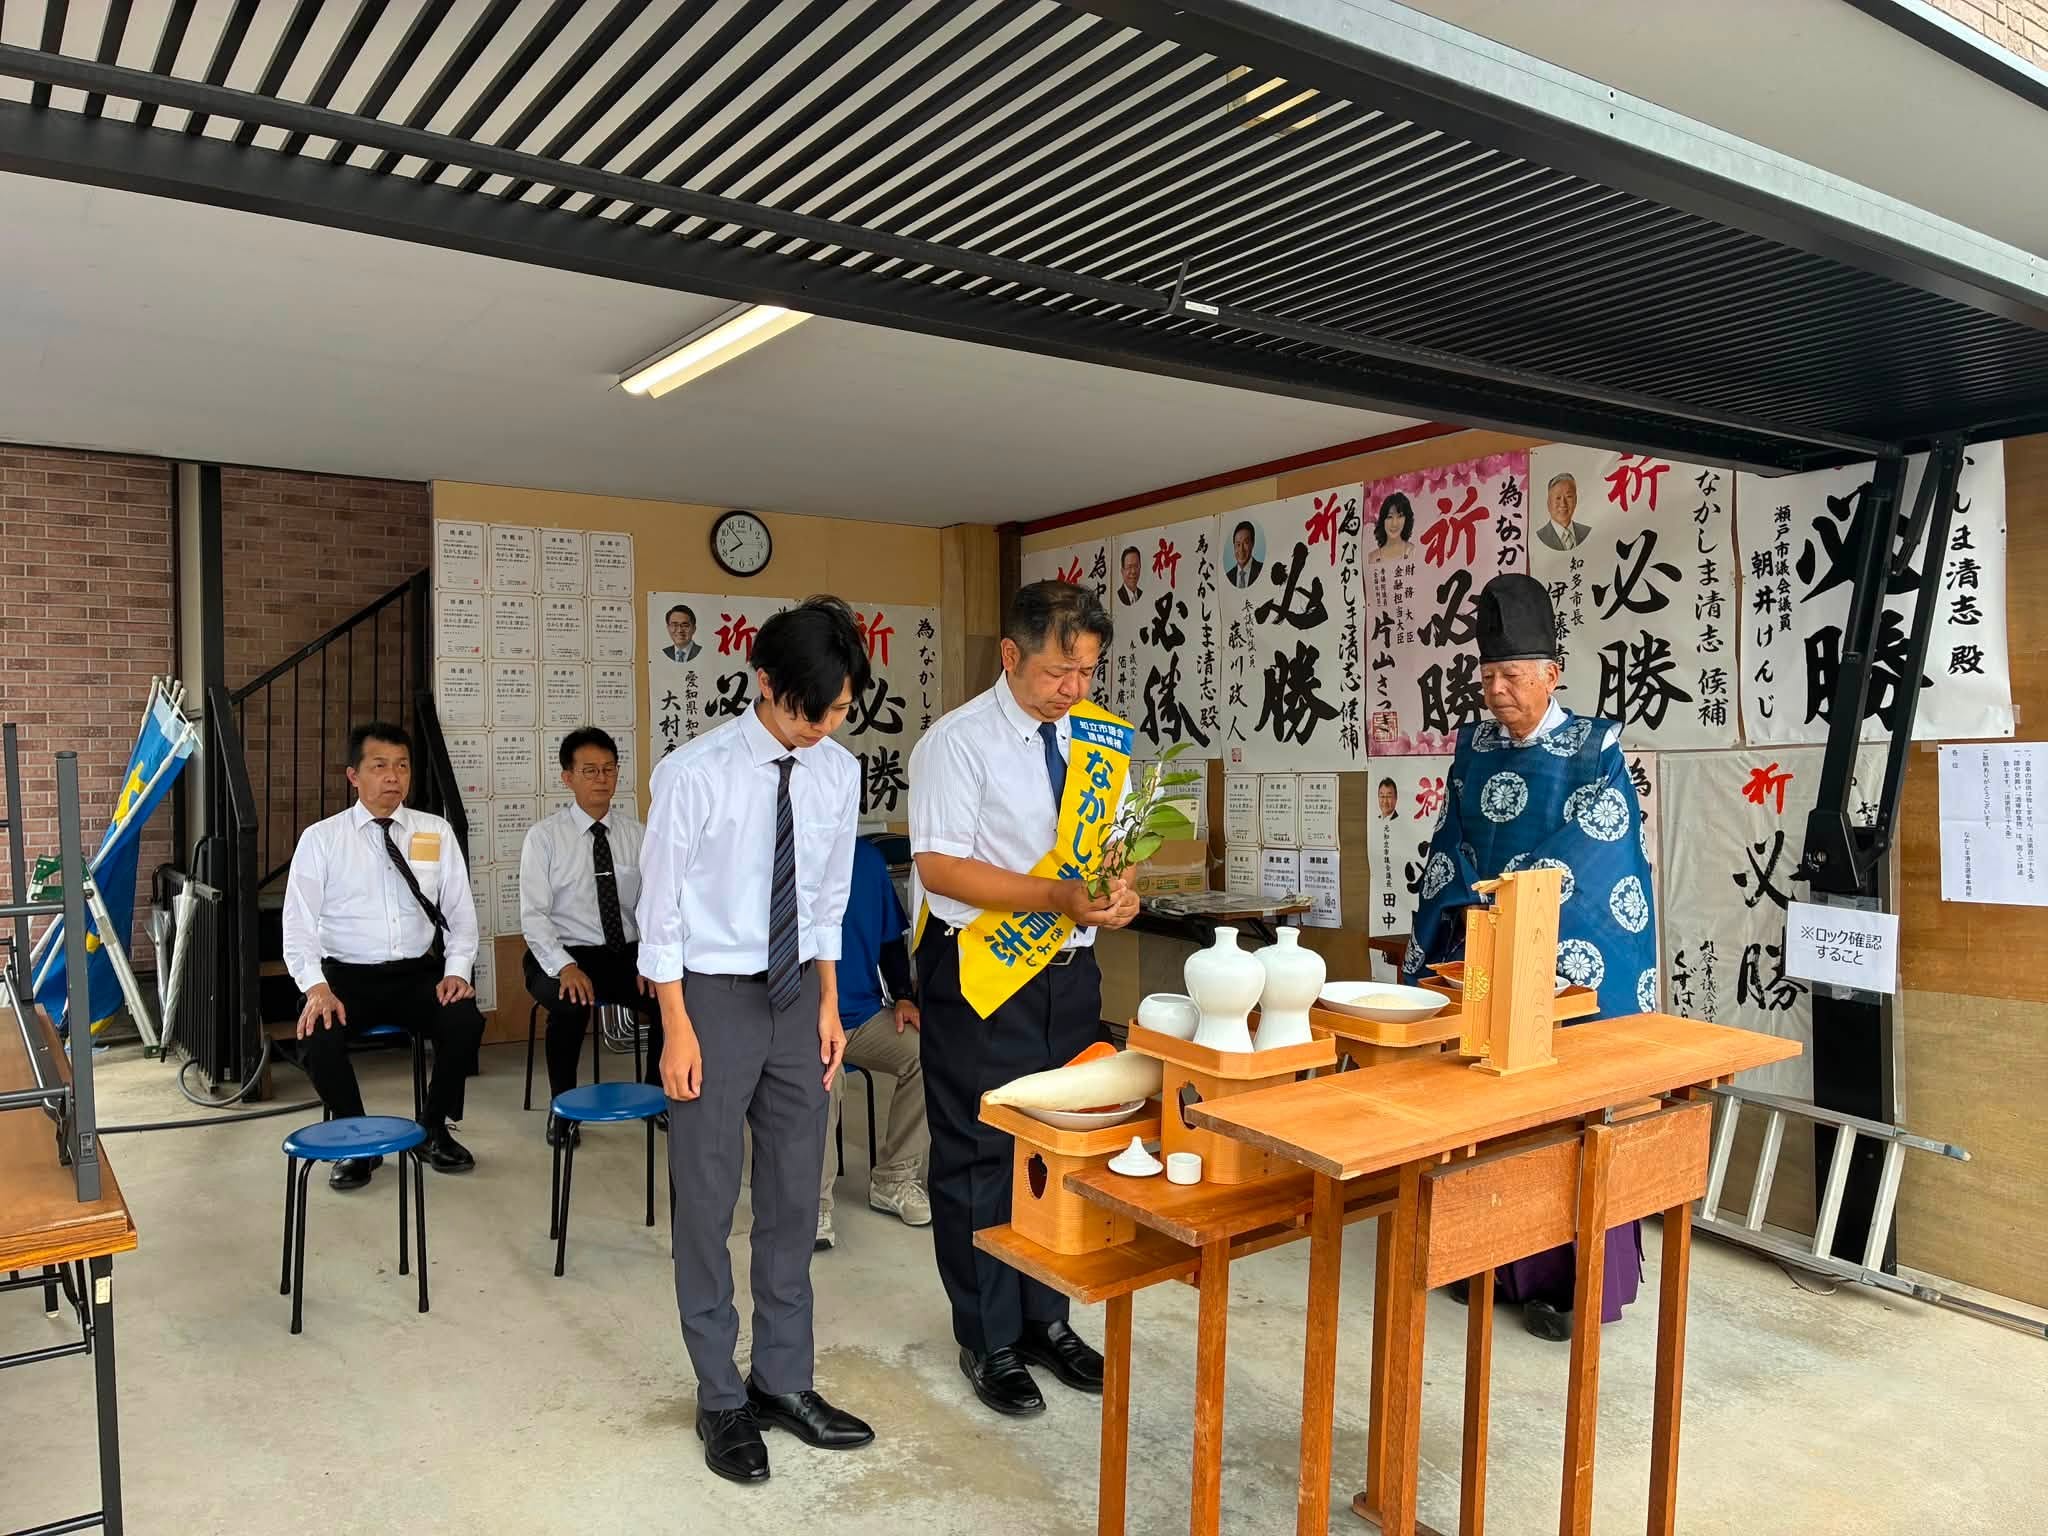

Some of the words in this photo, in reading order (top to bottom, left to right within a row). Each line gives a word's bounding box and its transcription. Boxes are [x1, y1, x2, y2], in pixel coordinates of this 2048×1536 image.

[1604, 453, 1670, 512] 祈
[1152, 538, 1182, 589] 祈
[1305, 492, 1341, 566] 祈
[1420, 486, 1490, 568] 祈
[1496, 475, 1525, 577] 為なか
[1693, 469, 1726, 653] なかしま清志
[1394, 564, 1405, 644] 金融担当大臣
[1404, 563, 1416, 643] 財務大臣
[1568, 556, 1585, 626] 知多市長
[1774, 504, 1793, 632] 瀬戸市議会議員
[714, 613, 758, 664] 祈
[1140, 591, 1210, 748] 必勝
[1254, 541, 1341, 746] 必勝
[1417, 569, 1489, 736] 必勝
[1592, 529, 1693, 731] 必勝
[1751, 550, 1777, 718] 朝井けんじ
[1948, 644, 1985, 676] 殿
[915, 618, 937, 731] 為なかしま
[1227, 619, 1249, 742] 藤川政人
[1697, 667, 1728, 727] 候補
[1742, 762, 1794, 815] 祈
[1025, 927, 1065, 968] きよし
[1382, 893, 1397, 931] 田中
[1815, 944, 1864, 966] すること
